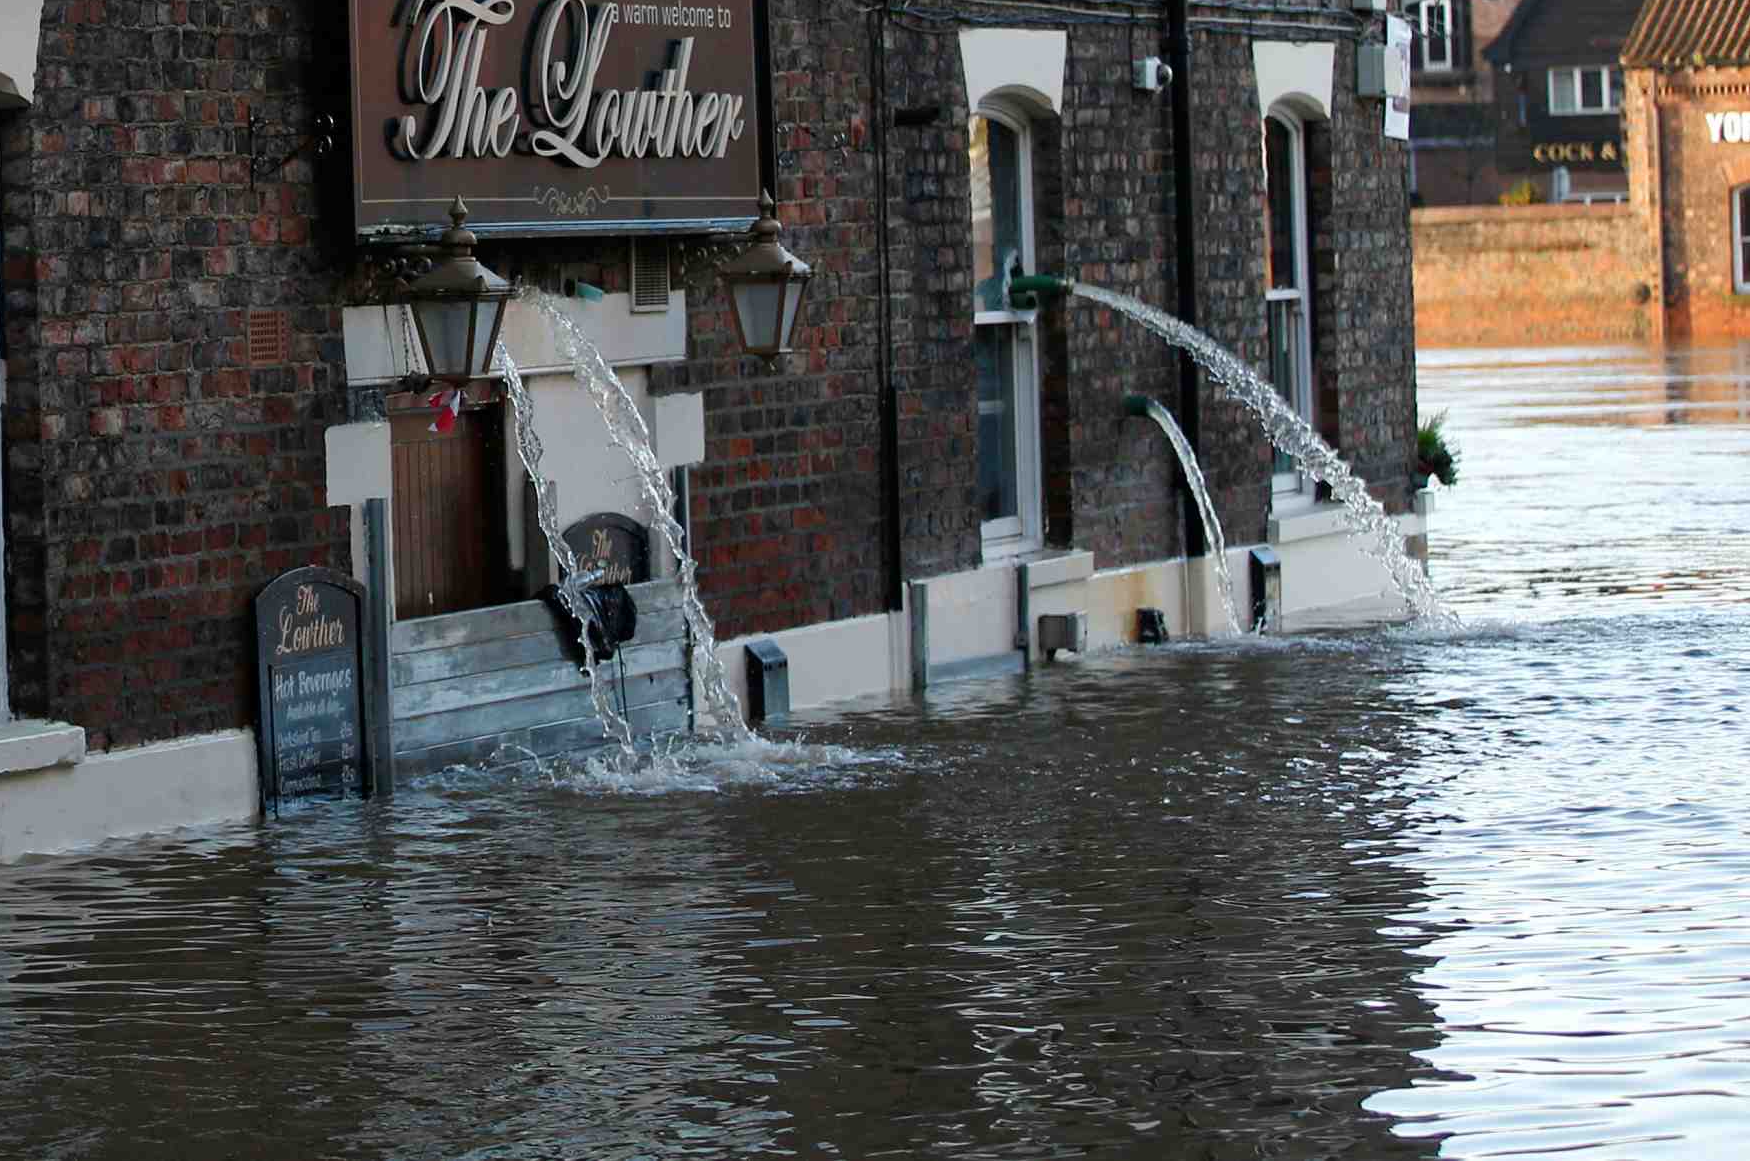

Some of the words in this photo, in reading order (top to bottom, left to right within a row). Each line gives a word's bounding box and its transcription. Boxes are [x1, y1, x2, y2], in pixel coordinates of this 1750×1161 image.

[611, 6, 620, 24] a
[623, 5, 658, 26] warm
[662, 0, 714, 27] welcome
[717, 9, 732, 29] to
[1532, 142, 1595, 163] COCK
[1599, 139, 1618, 161] &
[296, 583, 320, 616] The
[275, 605, 345, 656] Lowther
[274, 672, 294, 703] Hot
